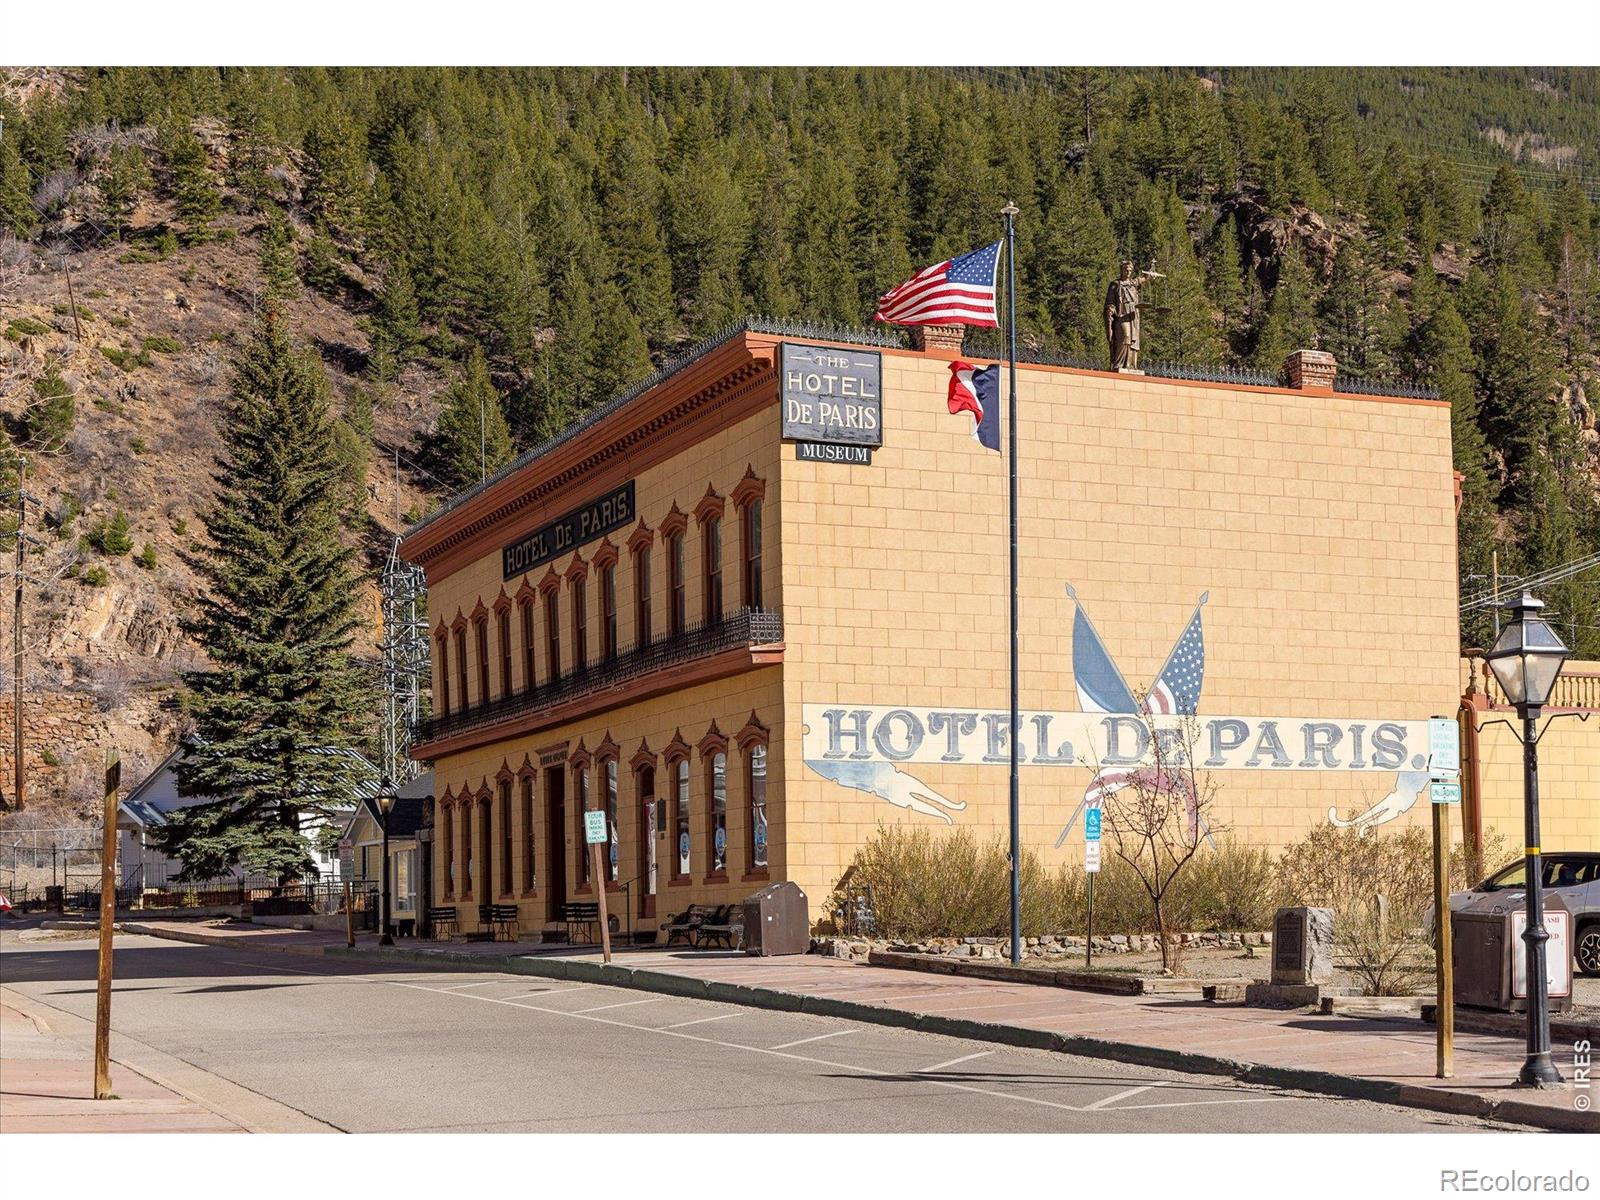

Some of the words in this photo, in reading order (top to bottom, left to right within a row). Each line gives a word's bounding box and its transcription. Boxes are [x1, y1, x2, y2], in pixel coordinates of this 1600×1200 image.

[814, 355, 849, 369] THE
[787, 371, 876, 398] HOTEL
[787, 399, 813, 425] DE
[819, 402, 877, 430] PARIS
[802, 443, 868, 462] MUSEUM
[506, 533, 548, 574] HOTEL
[821, 708, 1075, 765] HOTEL
[1205, 718, 1427, 770] PARIS.
